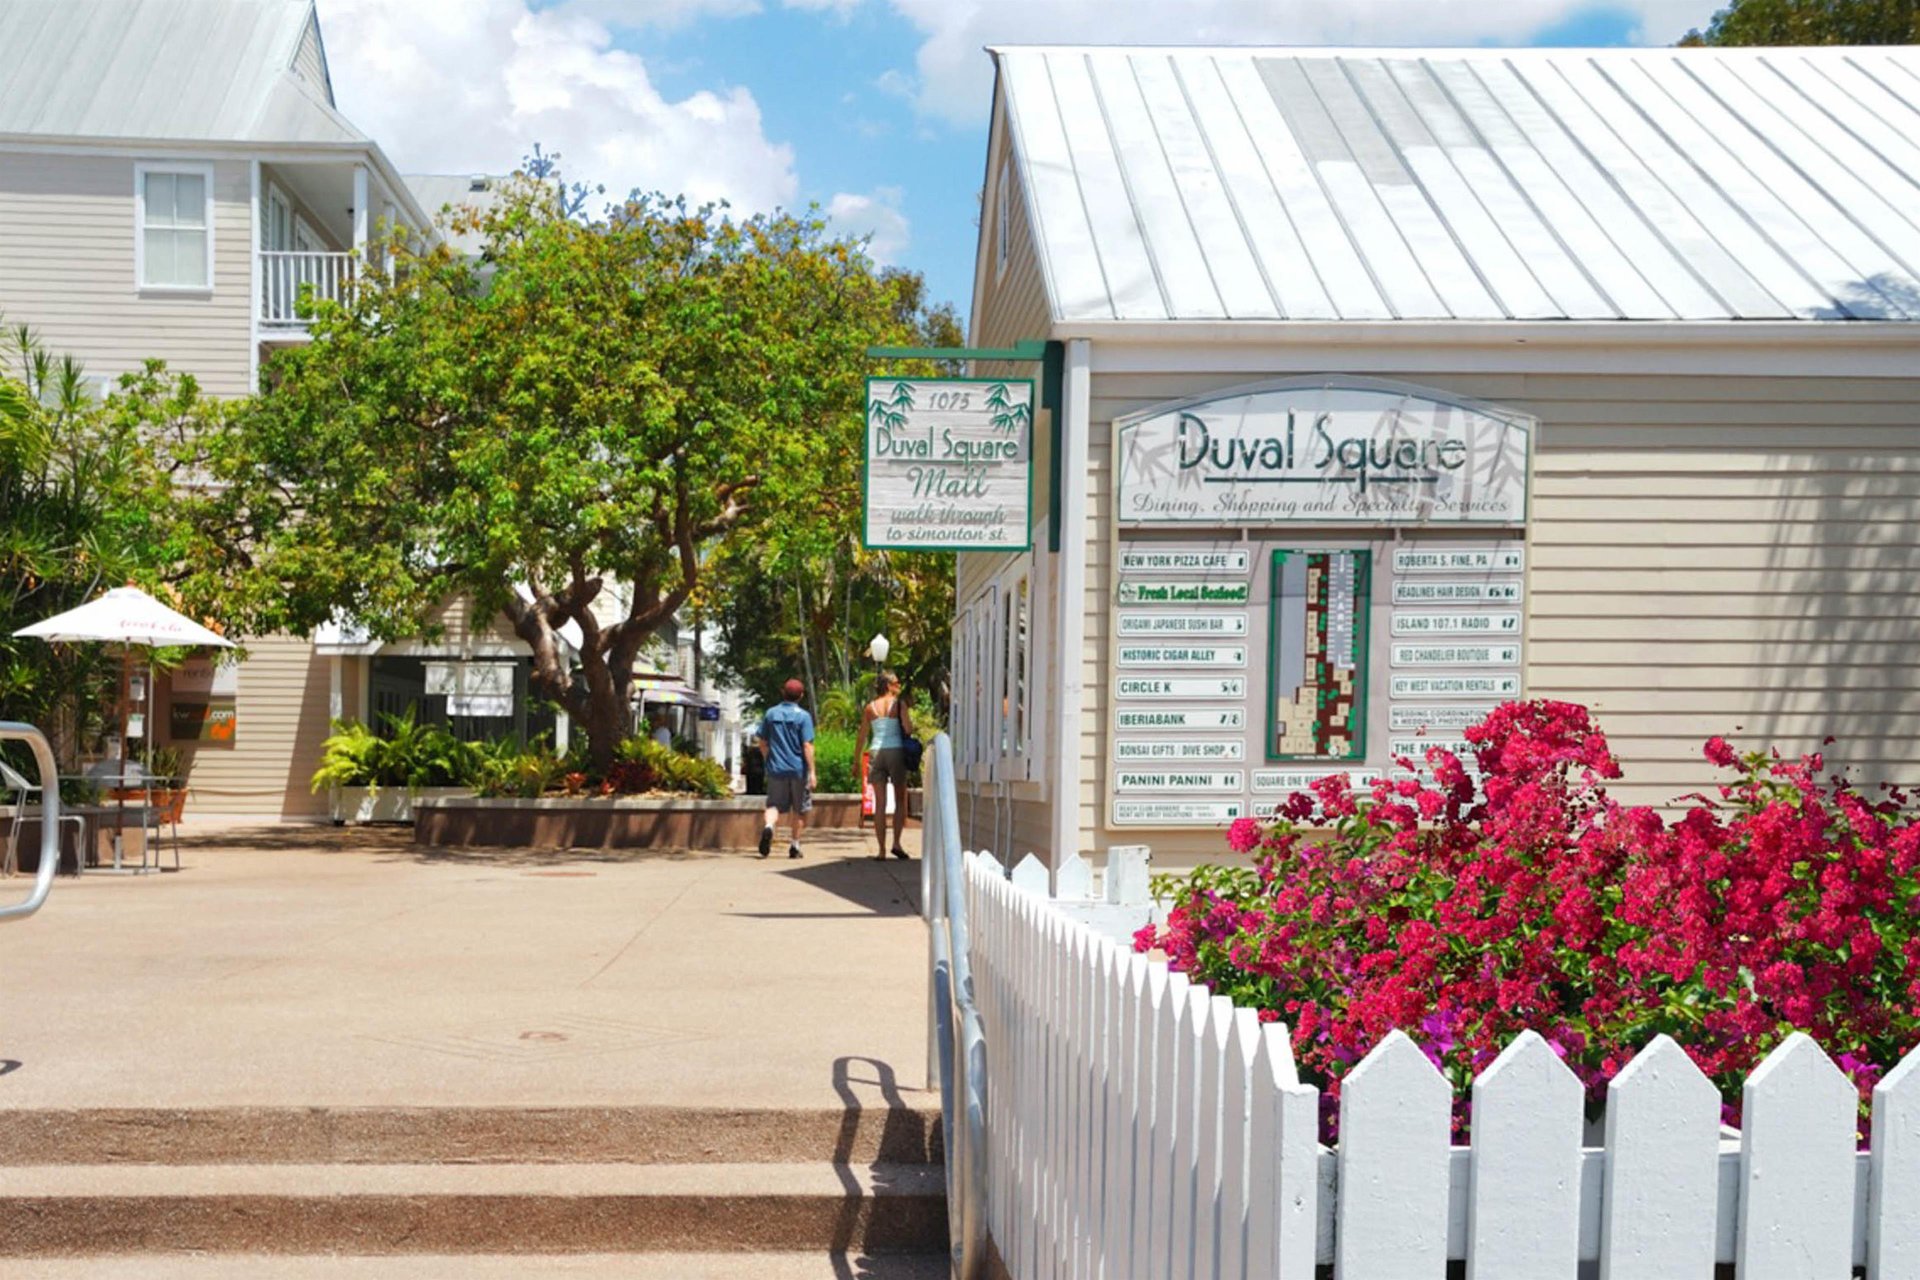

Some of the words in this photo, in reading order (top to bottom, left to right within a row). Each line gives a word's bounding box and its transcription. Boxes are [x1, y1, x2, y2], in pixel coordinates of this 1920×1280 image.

[930, 391, 970, 409] 1075
[876, 426, 934, 457] Duval
[943, 428, 1018, 468] Square
[1179, 412, 1294, 470] Duval
[1315, 413, 1466, 492] Square
[907, 466, 990, 498] Mall
[1213, 491, 1298, 518] Shopping
[1303, 495, 1335, 512] and
[1435, 493, 1510, 512] Services
[887, 526, 902, 541] to
[907, 527, 984, 541] simonton
[1123, 555, 1144, 566] NEW
[1147, 555, 1171, 566] YORK
[1174, 555, 1200, 566] PIZZA
[1203, 555, 1226, 566] CAFE
[1398, 555, 1437, 566] ROBERTA
[1476, 555, 1488, 565] PA
[1138, 585, 1168, 599] Fresh
[1171, 585, 1199, 599] Local
[1397, 587, 1435, 597] HEADLINES
[1437, 587, 1453, 597] HAIR
[1455, 587, 1480, 597] DESIGN
[1122, 619, 1151, 630] ORIGAMI
[1153, 619, 1186, 630] JAPANESE
[1188, 619, 1208, 630] SUSHI
[1210, 619, 1223, 630] BAR
[1397, 618, 1429, 629] ISLAND
[1433, 618, 1458, 629] 107.1
[1461, 617, 1490, 628] RADIO
[1122, 650, 1161, 661] HISTORIC
[1163, 650, 1188, 661] CIGAR
[1191, 650, 1215, 661] ALLEY
[1400, 650, 1413, 660] RED
[1415, 649, 1455, 660] CHANDELIER
[1457, 649, 1489, 660] BOUTIQUE
[1121, 682, 1160, 693] CIRCLE
[1164, 682, 1171, 693] K
[1395, 681, 1408, 691] KEY
[1411, 681, 1428, 691] WEST
[1431, 681, 1463, 691] VACATION
[1465, 681, 1495, 691] RENTALS
[1120, 714, 1185, 725] IBERIABANK
[1120, 745, 1149, 756] BONSAI
[1152, 745, 1175, 756] GIFTS
[1182, 745, 1200, 756] DIVE
[1203, 745, 1225, 756] SHOP
[1395, 743, 1414, 754] THE
[1122, 775, 1165, 785] PANINI
[1169, 775, 1212, 785] PANINI
[1256, 776, 1285, 786] SQUARE
[1287, 776, 1302, 786] ONE
